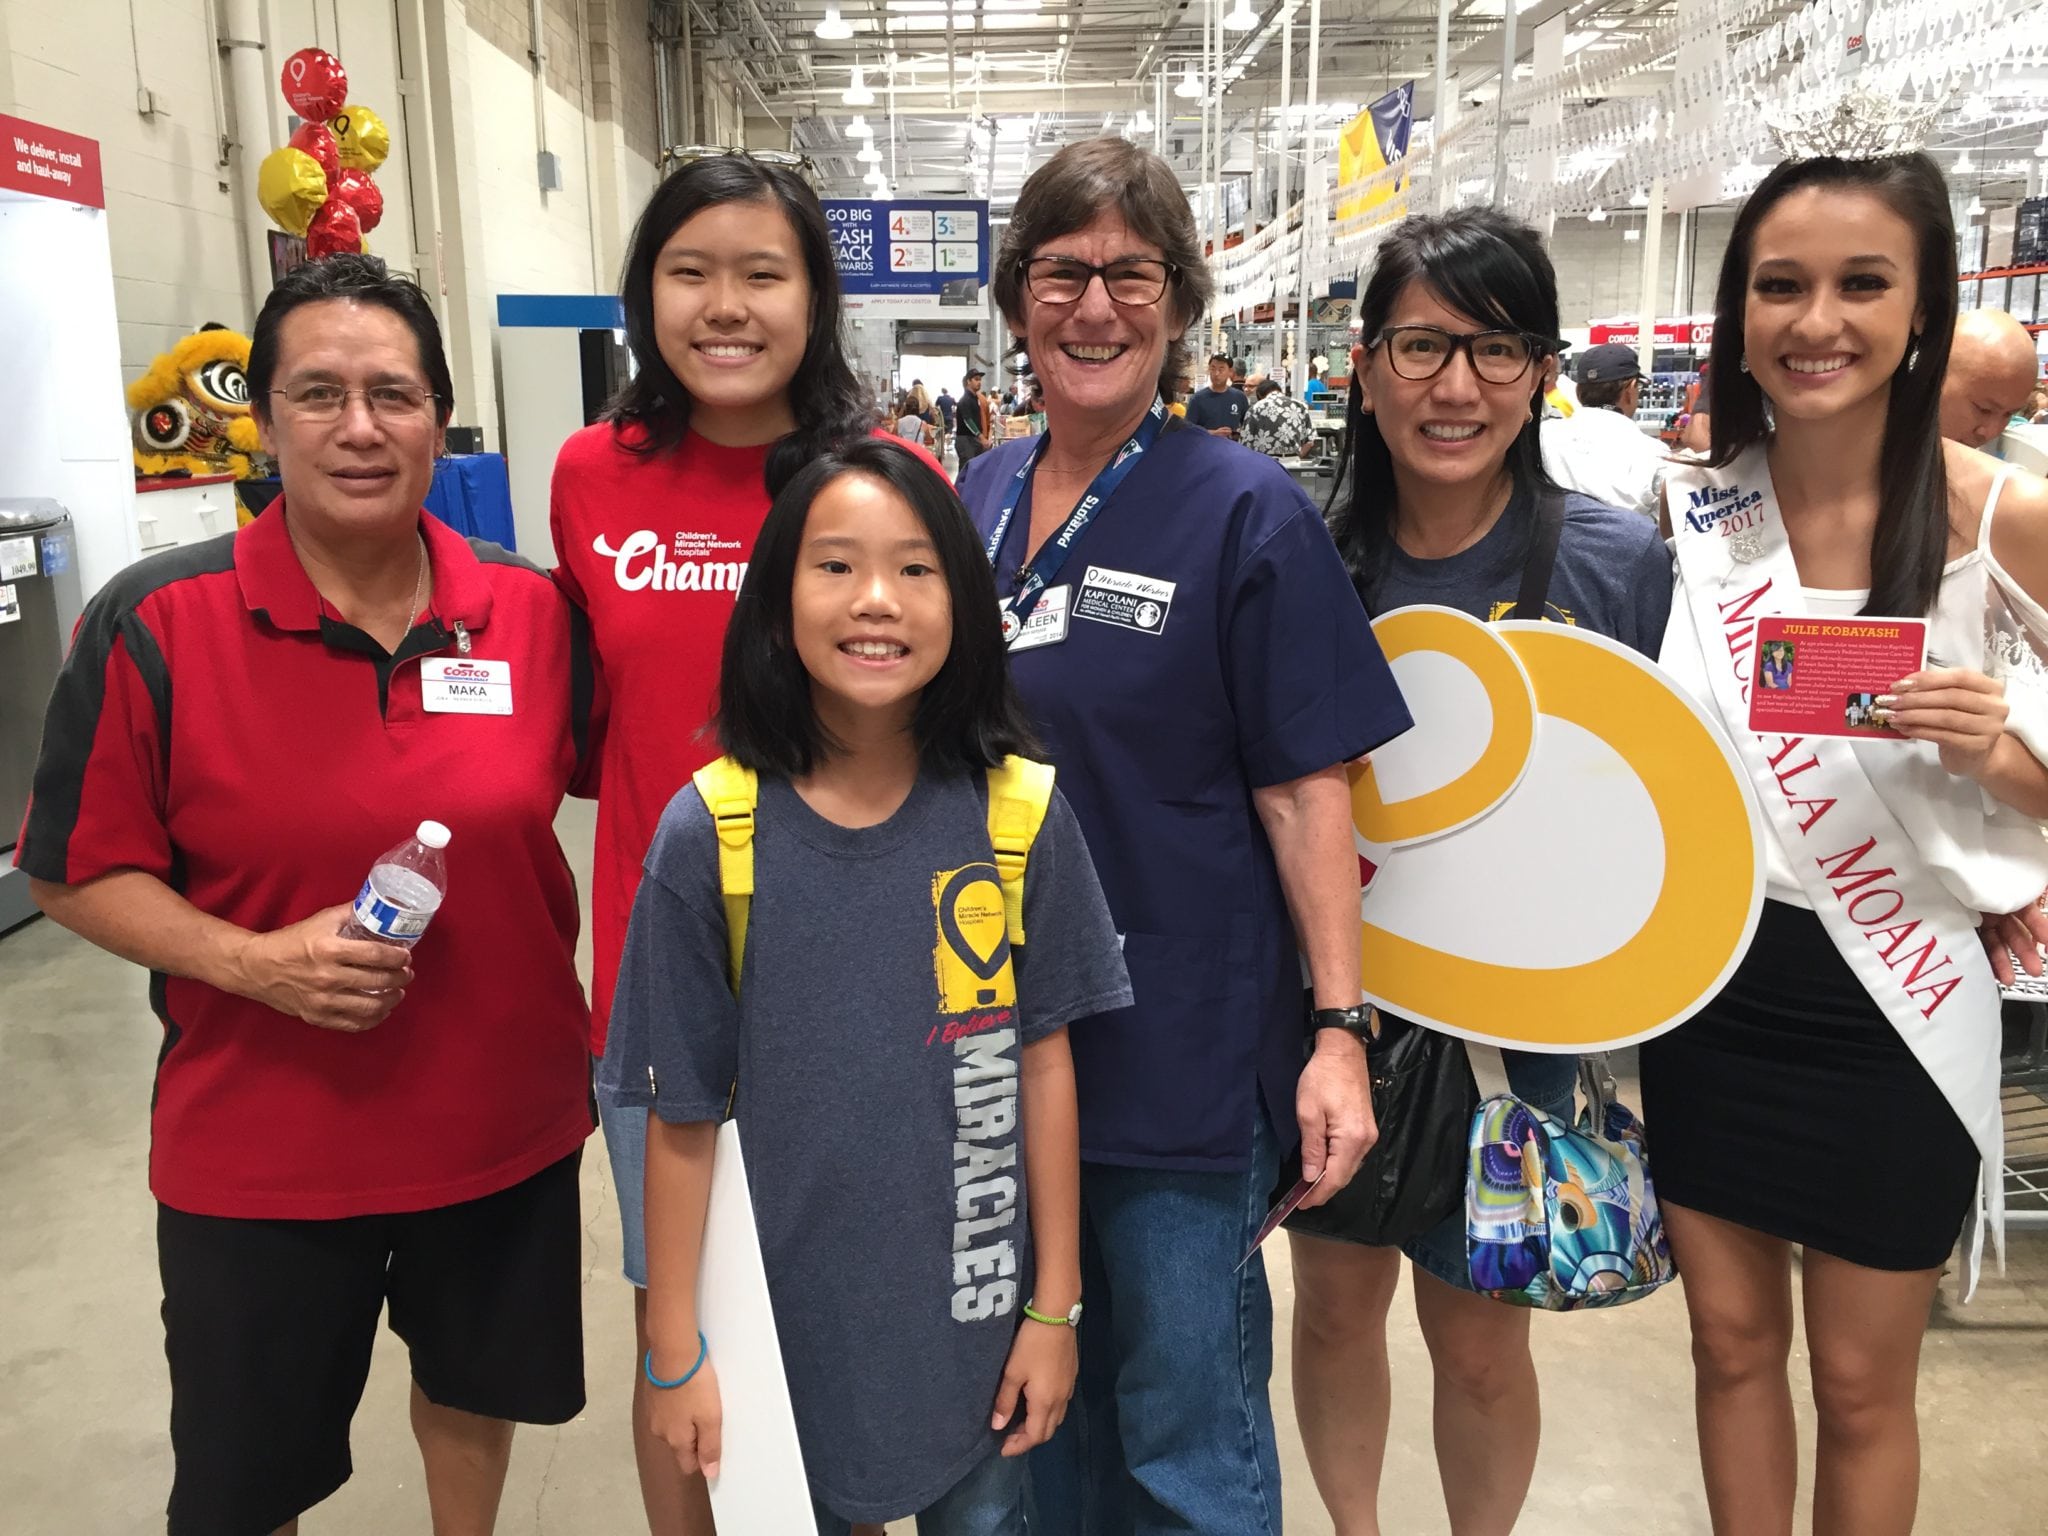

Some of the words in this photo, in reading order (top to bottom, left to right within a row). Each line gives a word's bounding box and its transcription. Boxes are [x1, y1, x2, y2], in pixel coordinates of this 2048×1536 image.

[1847, 34, 1863, 49] COS
[14, 137, 29, 154] We
[30, 141, 58, 163] deliver,
[58, 149, 82, 167] install
[17, 159, 32, 174] and
[33, 161, 71, 187] haul-away
[826, 209, 847, 221] GO
[850, 209, 872, 221] BIG
[827, 229, 873, 245] CASH
[830, 245, 873, 260] ACK
[1691, 326, 1713, 342] OP
[1687, 485, 1739, 509] Miss
[1684, 491, 1762, 533] America
[1719, 503, 1764, 537] 2017
[1057, 495, 1099, 548] PATRIOTS
[676, 531, 717, 540] Children's
[675, 540, 706, 548] Miracle
[1110, 603, 1135, 614] CENTER
[1782, 624, 1819, 635] JULIE
[1821, 625, 1900, 638] KOBAYASHI
[444, 667, 490, 678] COSTCO
[449, 685, 487, 696] MAKA
[1816, 836, 1964, 1020] MOANA
[926, 1025, 937, 1047] I
[941, 1010, 1012, 1043] Believe
[951, 1028, 1018, 1323] MIRACLES
